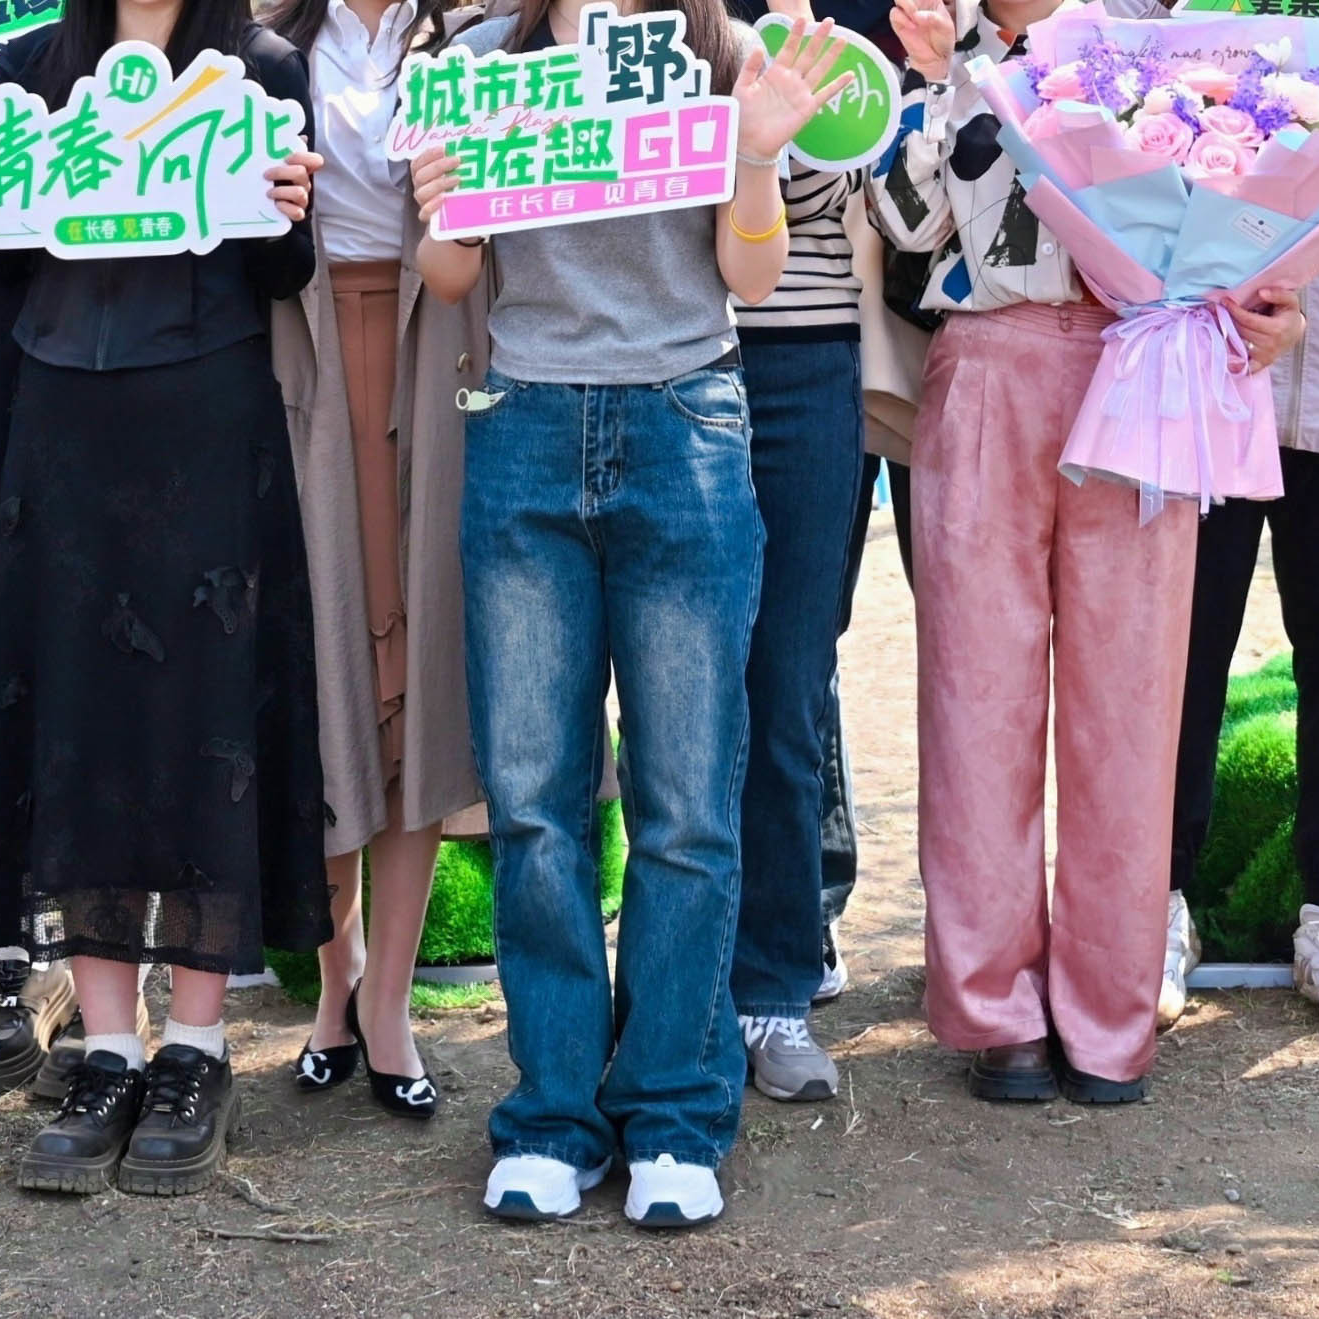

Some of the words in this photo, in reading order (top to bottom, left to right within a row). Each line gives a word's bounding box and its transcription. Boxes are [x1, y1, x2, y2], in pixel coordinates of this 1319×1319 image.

[117, 62, 154, 96] Hi
[490, 189, 577, 218] 在长春
[605, 176, 690, 205] 见青春
